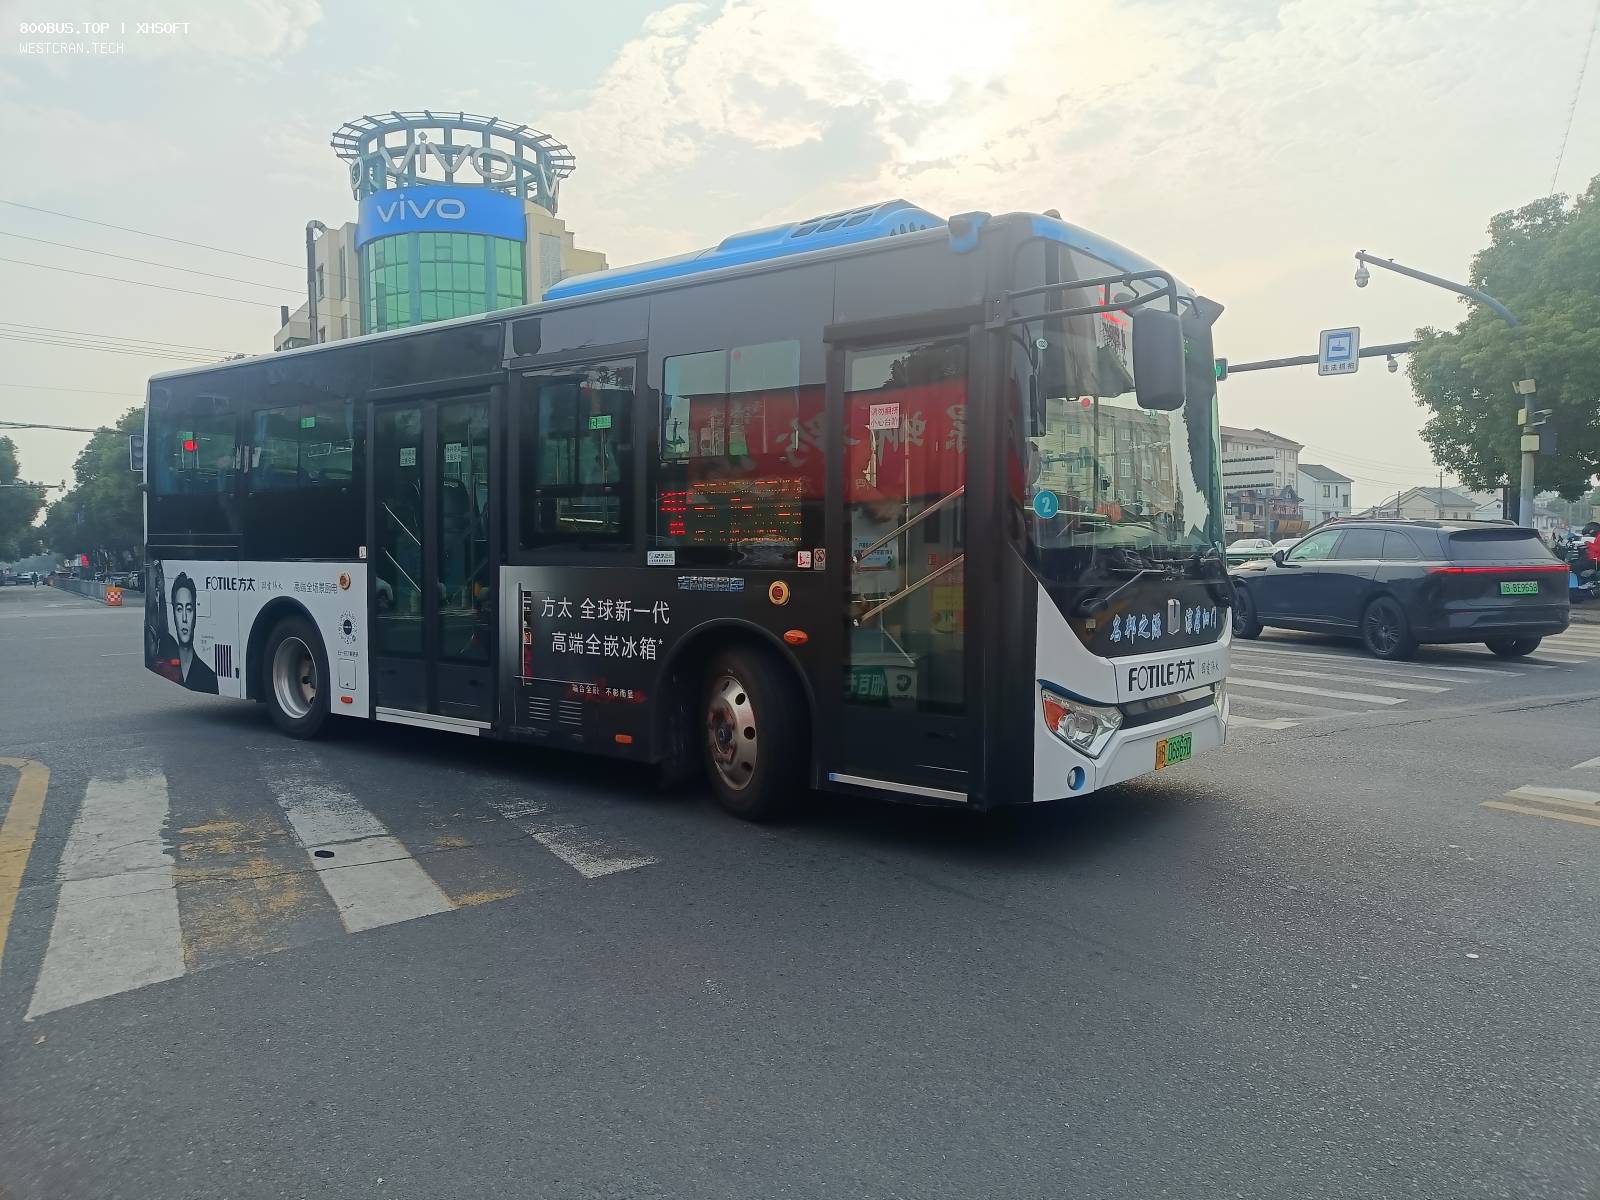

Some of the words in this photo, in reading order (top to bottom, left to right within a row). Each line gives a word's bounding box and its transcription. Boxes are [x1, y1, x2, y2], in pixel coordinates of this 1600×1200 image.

[380, 132, 514, 180] vivo
[377, 194, 465, 223] vivo
[1042, 496, 1052, 513] 2
[541, 596, 573, 619] 方太
[580, 597, 670, 625] 全球新一代
